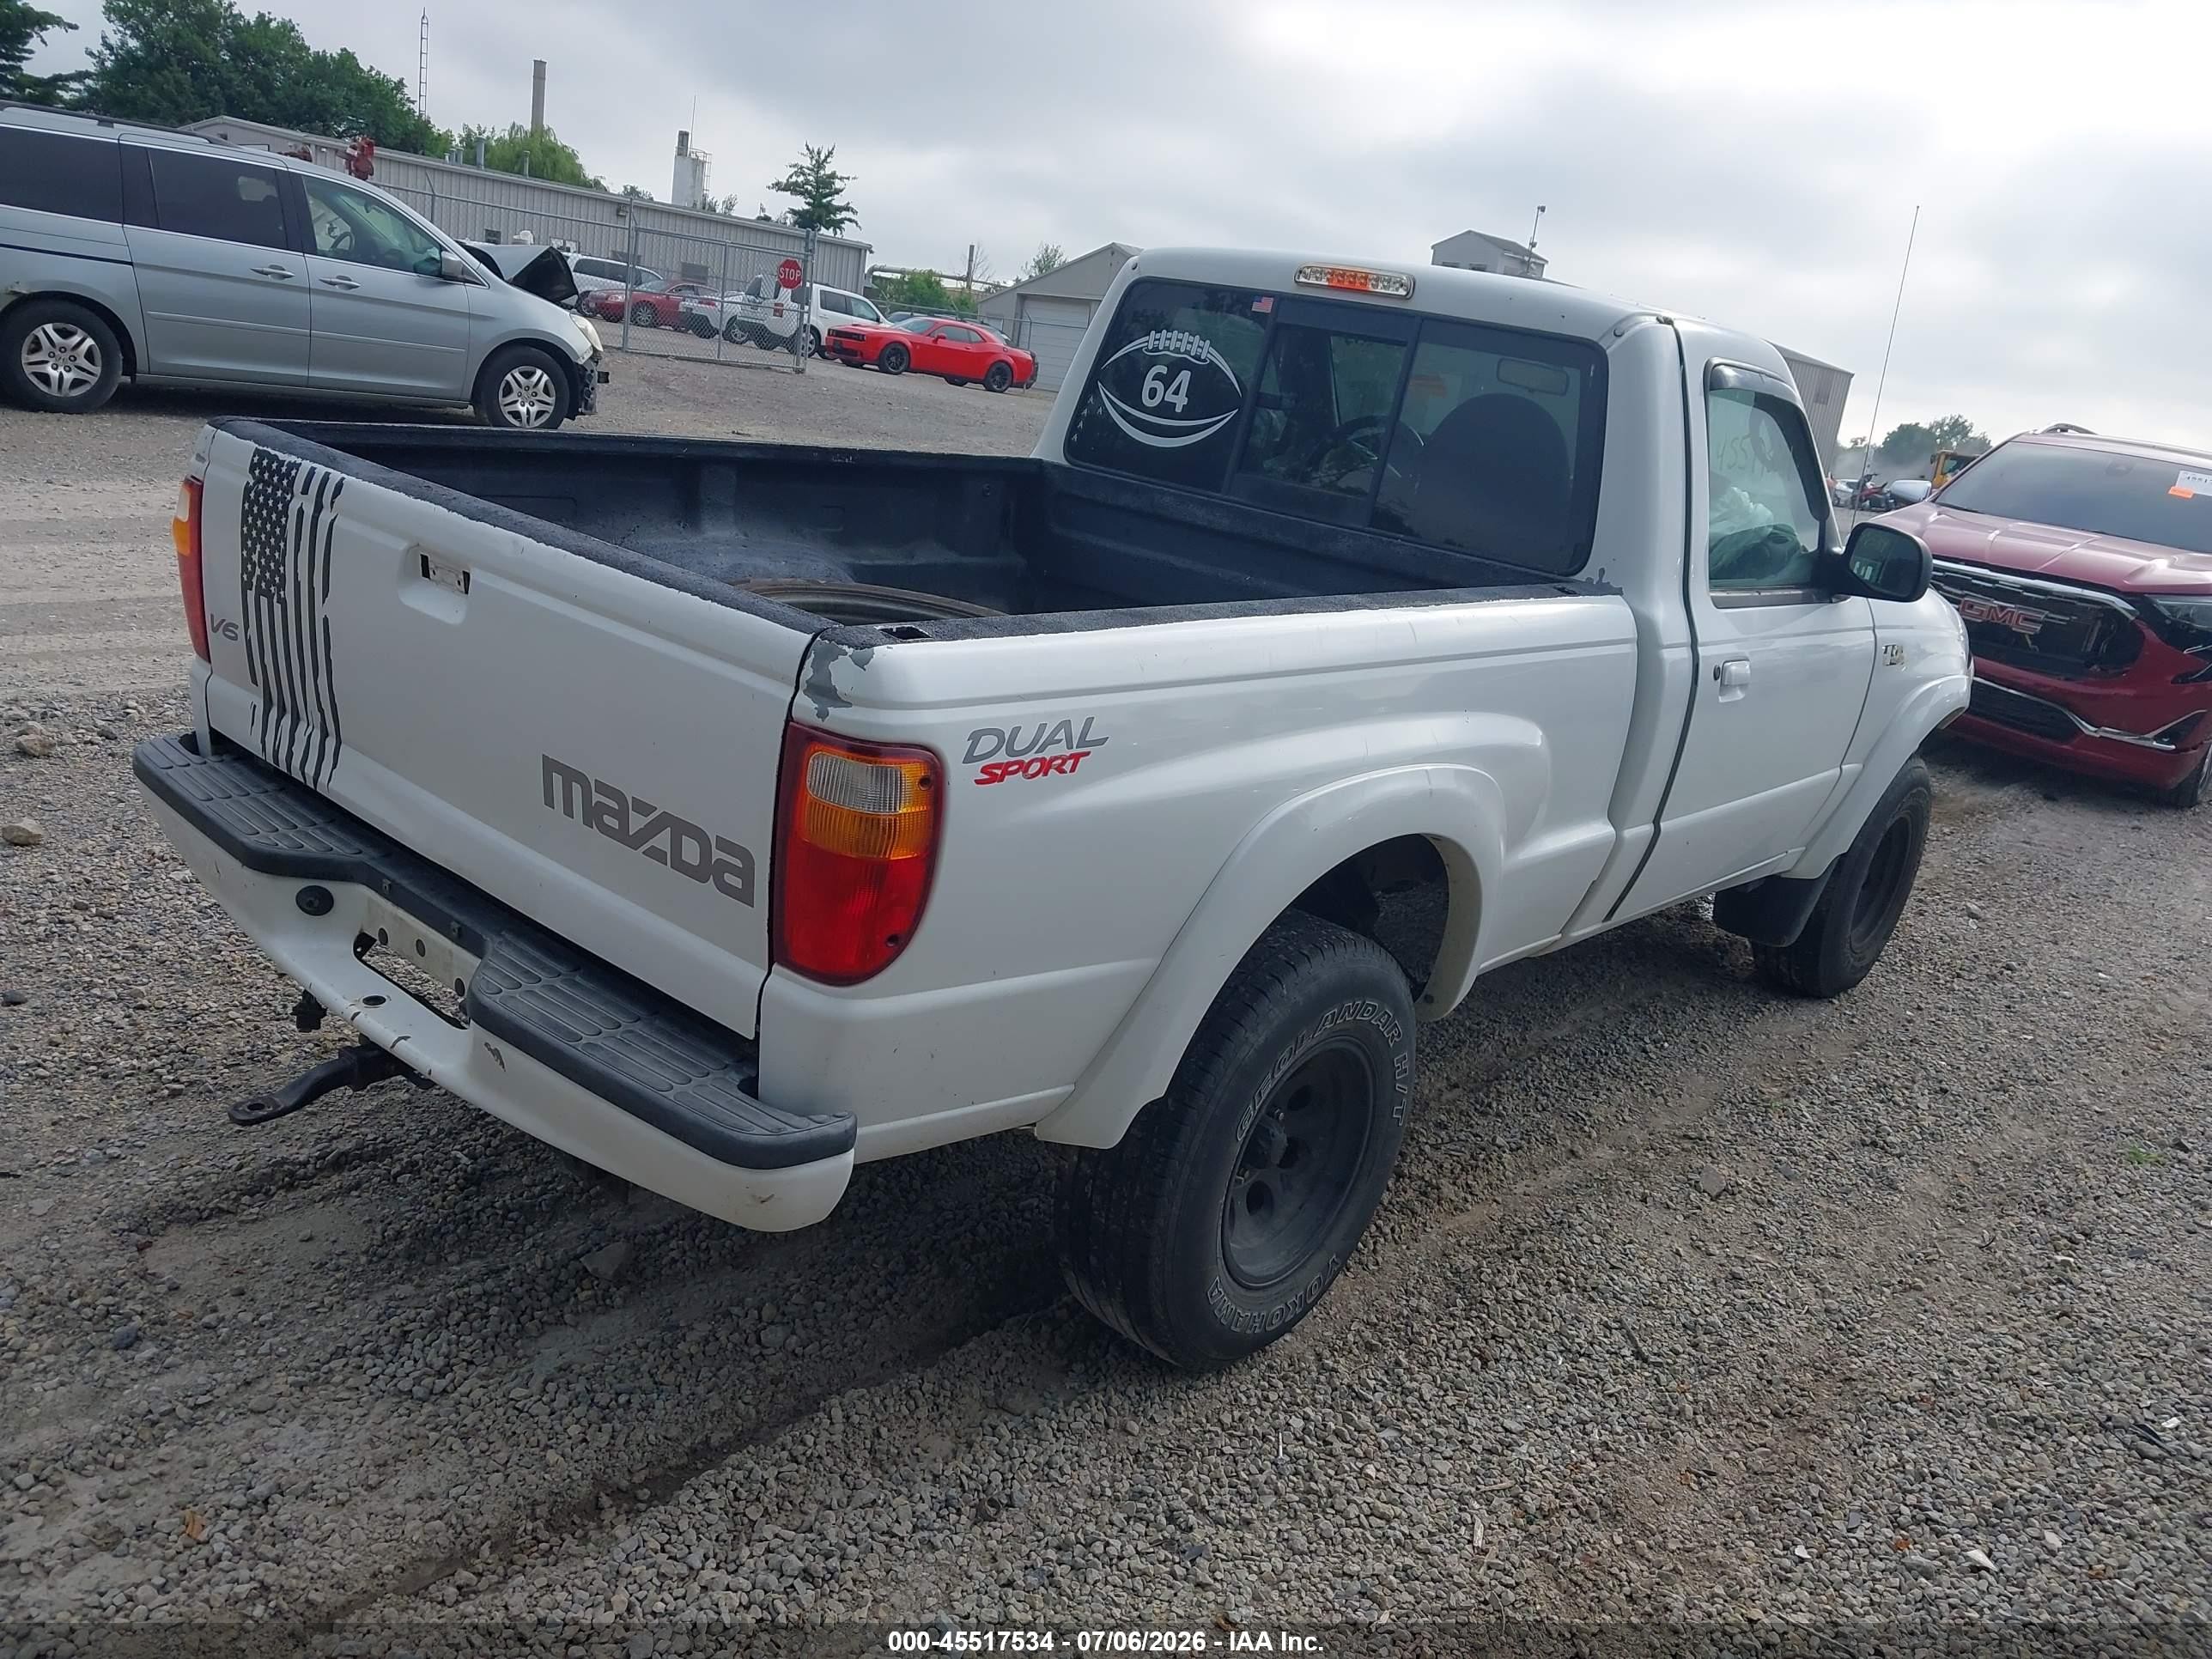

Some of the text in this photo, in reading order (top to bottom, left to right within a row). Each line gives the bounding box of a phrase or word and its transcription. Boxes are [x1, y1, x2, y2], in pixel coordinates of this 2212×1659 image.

[779, 267, 801, 282] STOP
[1141, 364, 1192, 413] 64
[210, 612, 240, 642] V6
[1960, 598, 2049, 635] GMC
[961, 716, 1110, 765] DUAL
[973, 750, 1092, 787] SPORT
[1237, 1000, 1410, 1142] GEOLANDAR H/T
[1206, 1253, 1342, 1334] YOKOHAMA
